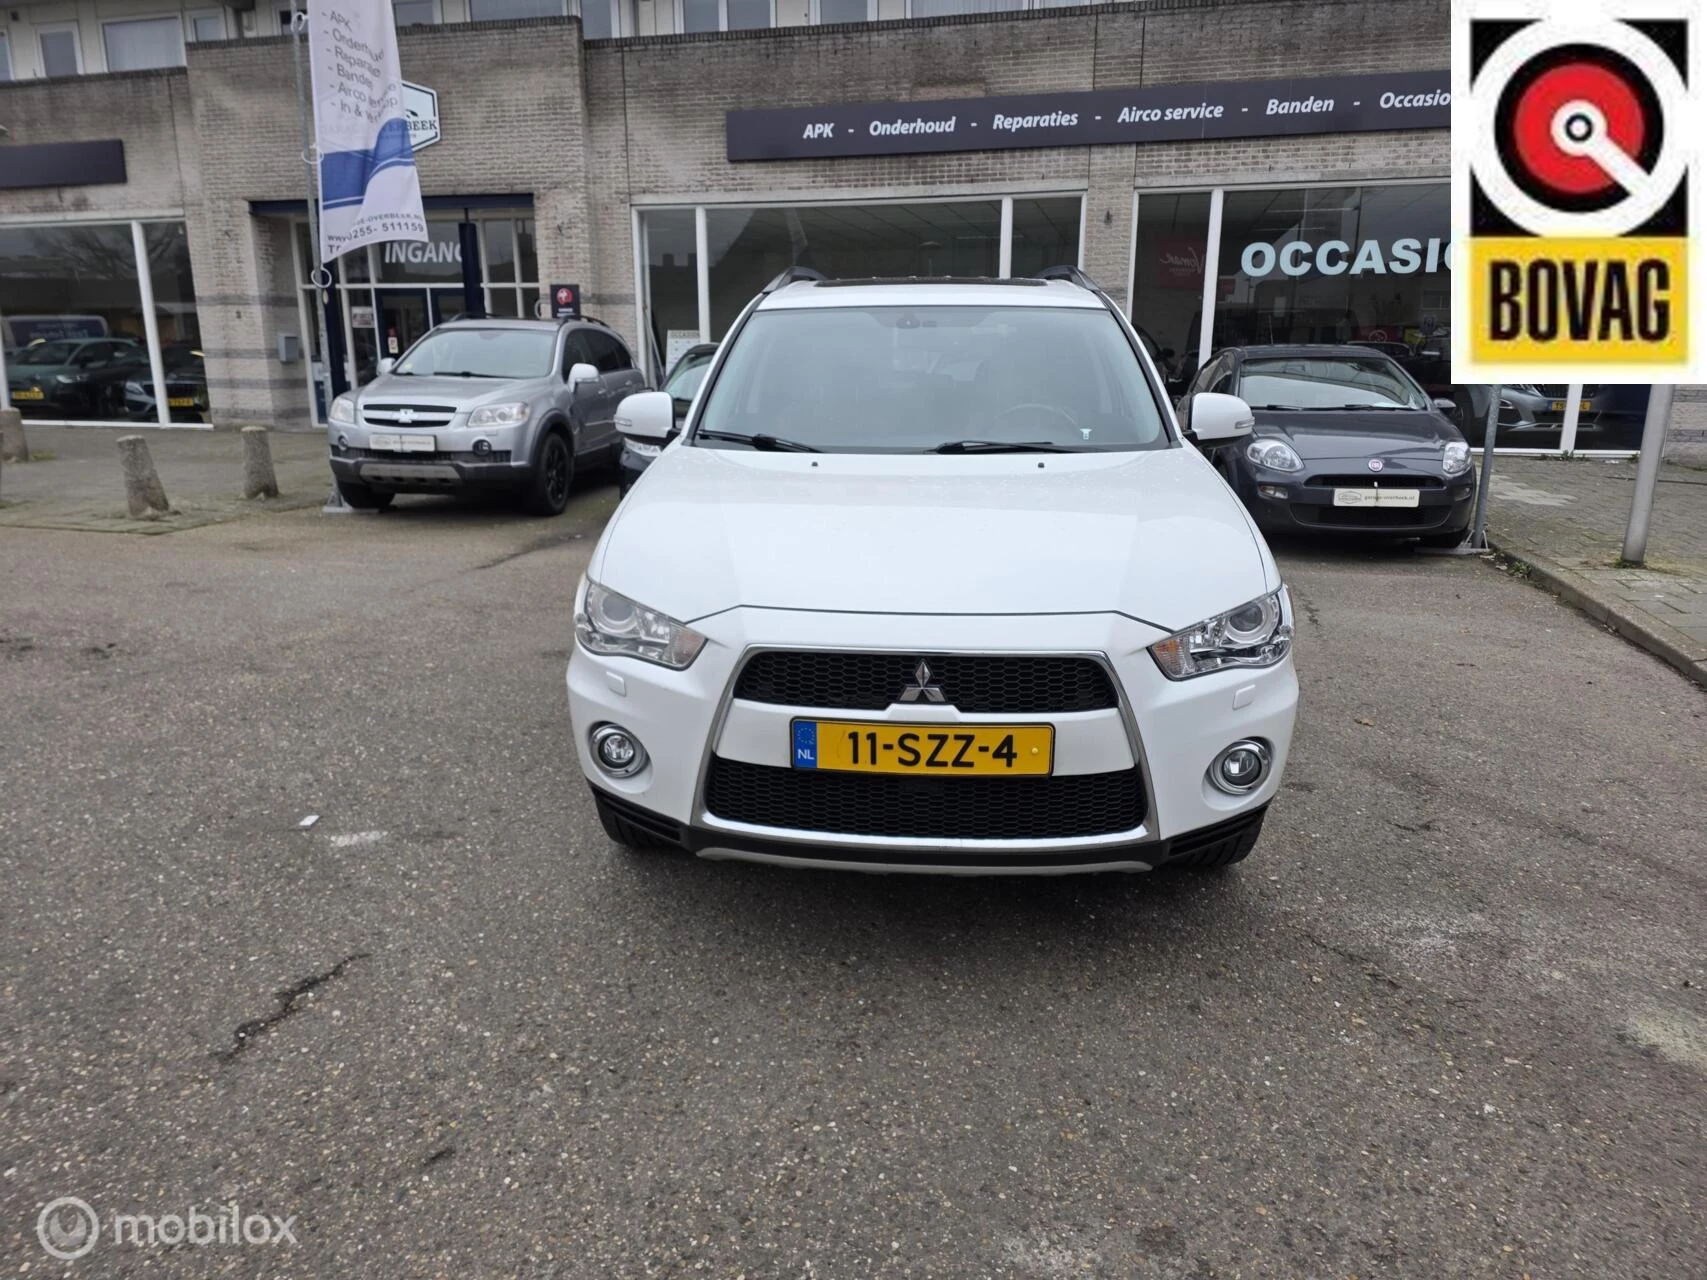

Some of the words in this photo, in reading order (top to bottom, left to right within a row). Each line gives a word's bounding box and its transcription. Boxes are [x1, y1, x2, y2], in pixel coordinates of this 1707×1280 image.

[803, 123, 835, 139] APK
[869, 116, 957, 136] Onderhoud
[993, 110, 1079, 133] Reparaties
[1117, 106, 1162, 123] Airco
[1164, 102, 1224, 121] service
[1266, 96, 1335, 116] Banden
[1379, 88, 1451, 109] Occasio
[1241, 238, 1451, 277] OCCASI
[797, 749, 815, 760] NL
[848, 731, 1018, 768] 11-SZZ-4
